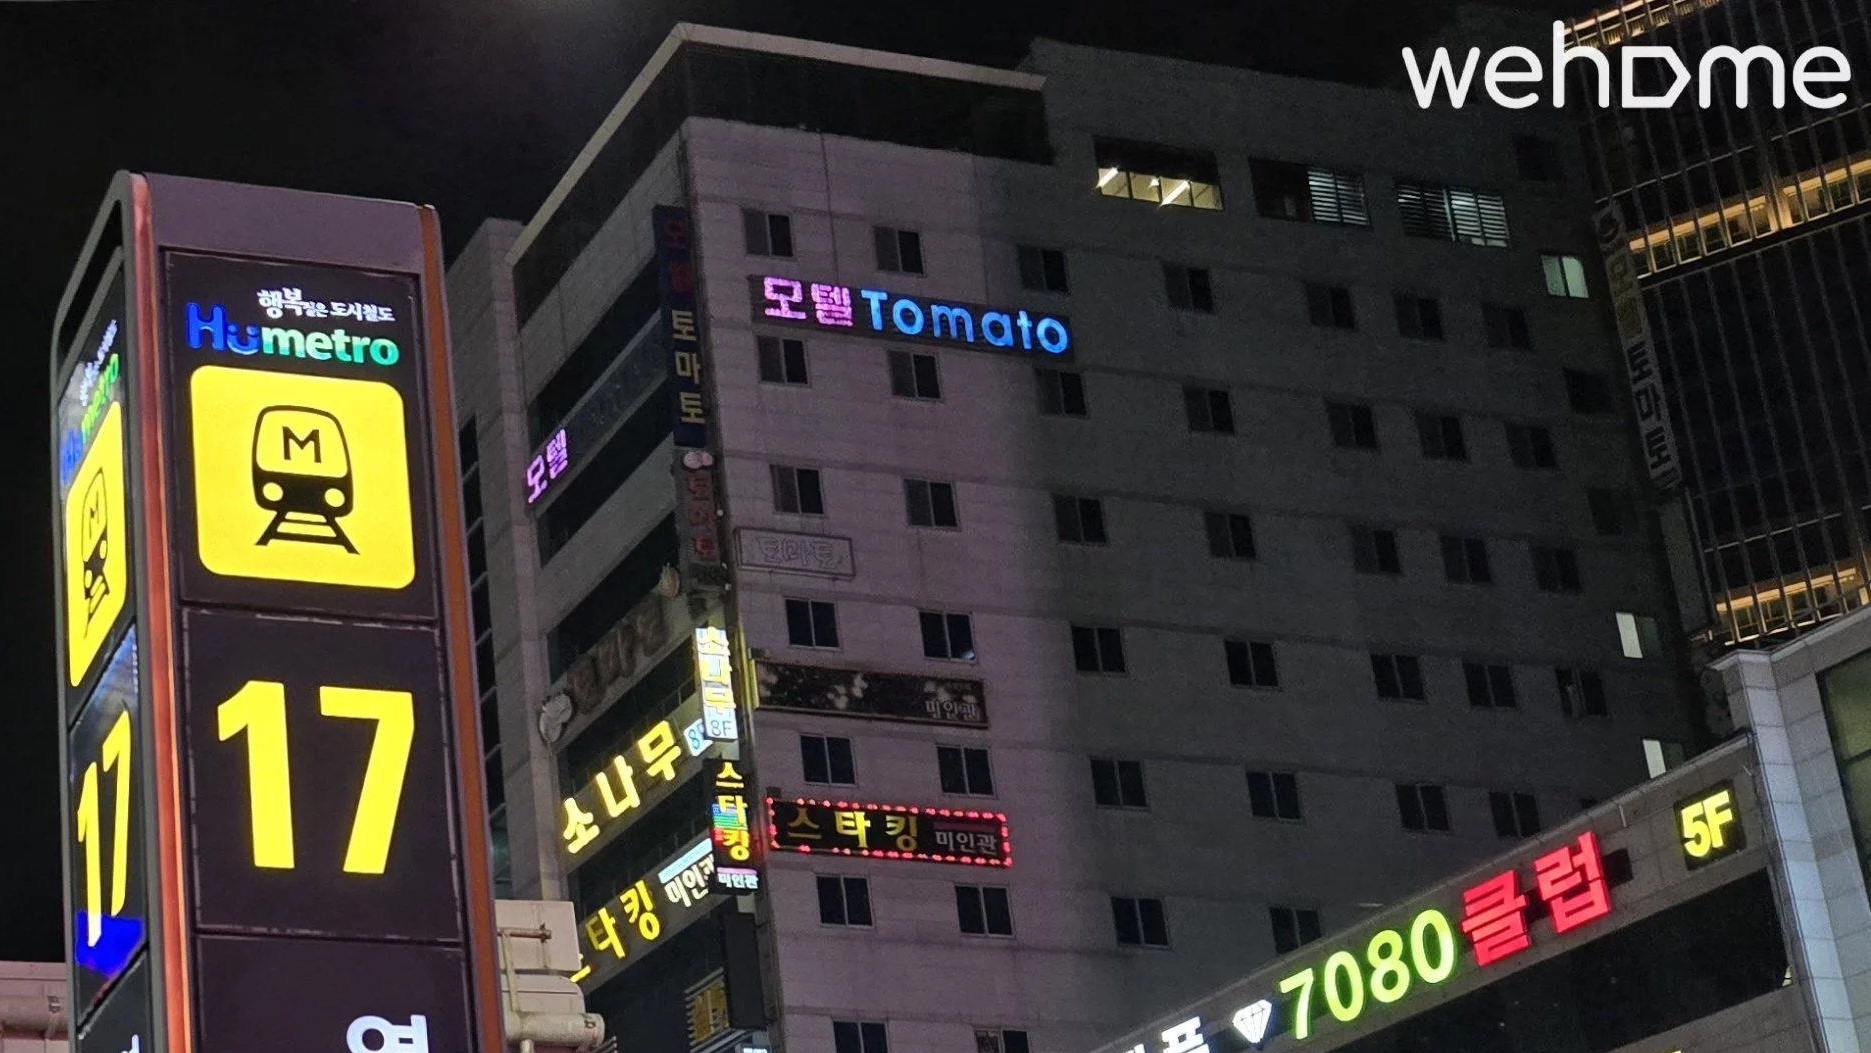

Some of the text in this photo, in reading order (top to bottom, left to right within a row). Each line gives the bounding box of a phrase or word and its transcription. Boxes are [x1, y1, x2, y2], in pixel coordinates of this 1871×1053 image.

[186, 301, 400, 366] Humetro
[330, 301, 396, 323] 도시철도
[762, 274, 1070, 355] 모텔 Tomato
[671, 308, 707, 425] 토마토
[282, 426, 322, 464] M
[527, 427, 569, 504] 모텔
[696, 626, 736, 716] 소나무
[710, 719, 732, 738] 8F
[217, 679, 414, 875] 17
[561, 720, 684, 855] 소나무
[715, 761, 750, 862] 스타킹
[77, 710, 131, 948] 17
[787, 807, 998, 856] 스타킹 미인관
[1677, 789, 1734, 861] 5F
[717, 873, 759, 890] 미인관
[571, 880, 661, 983] 타킹
